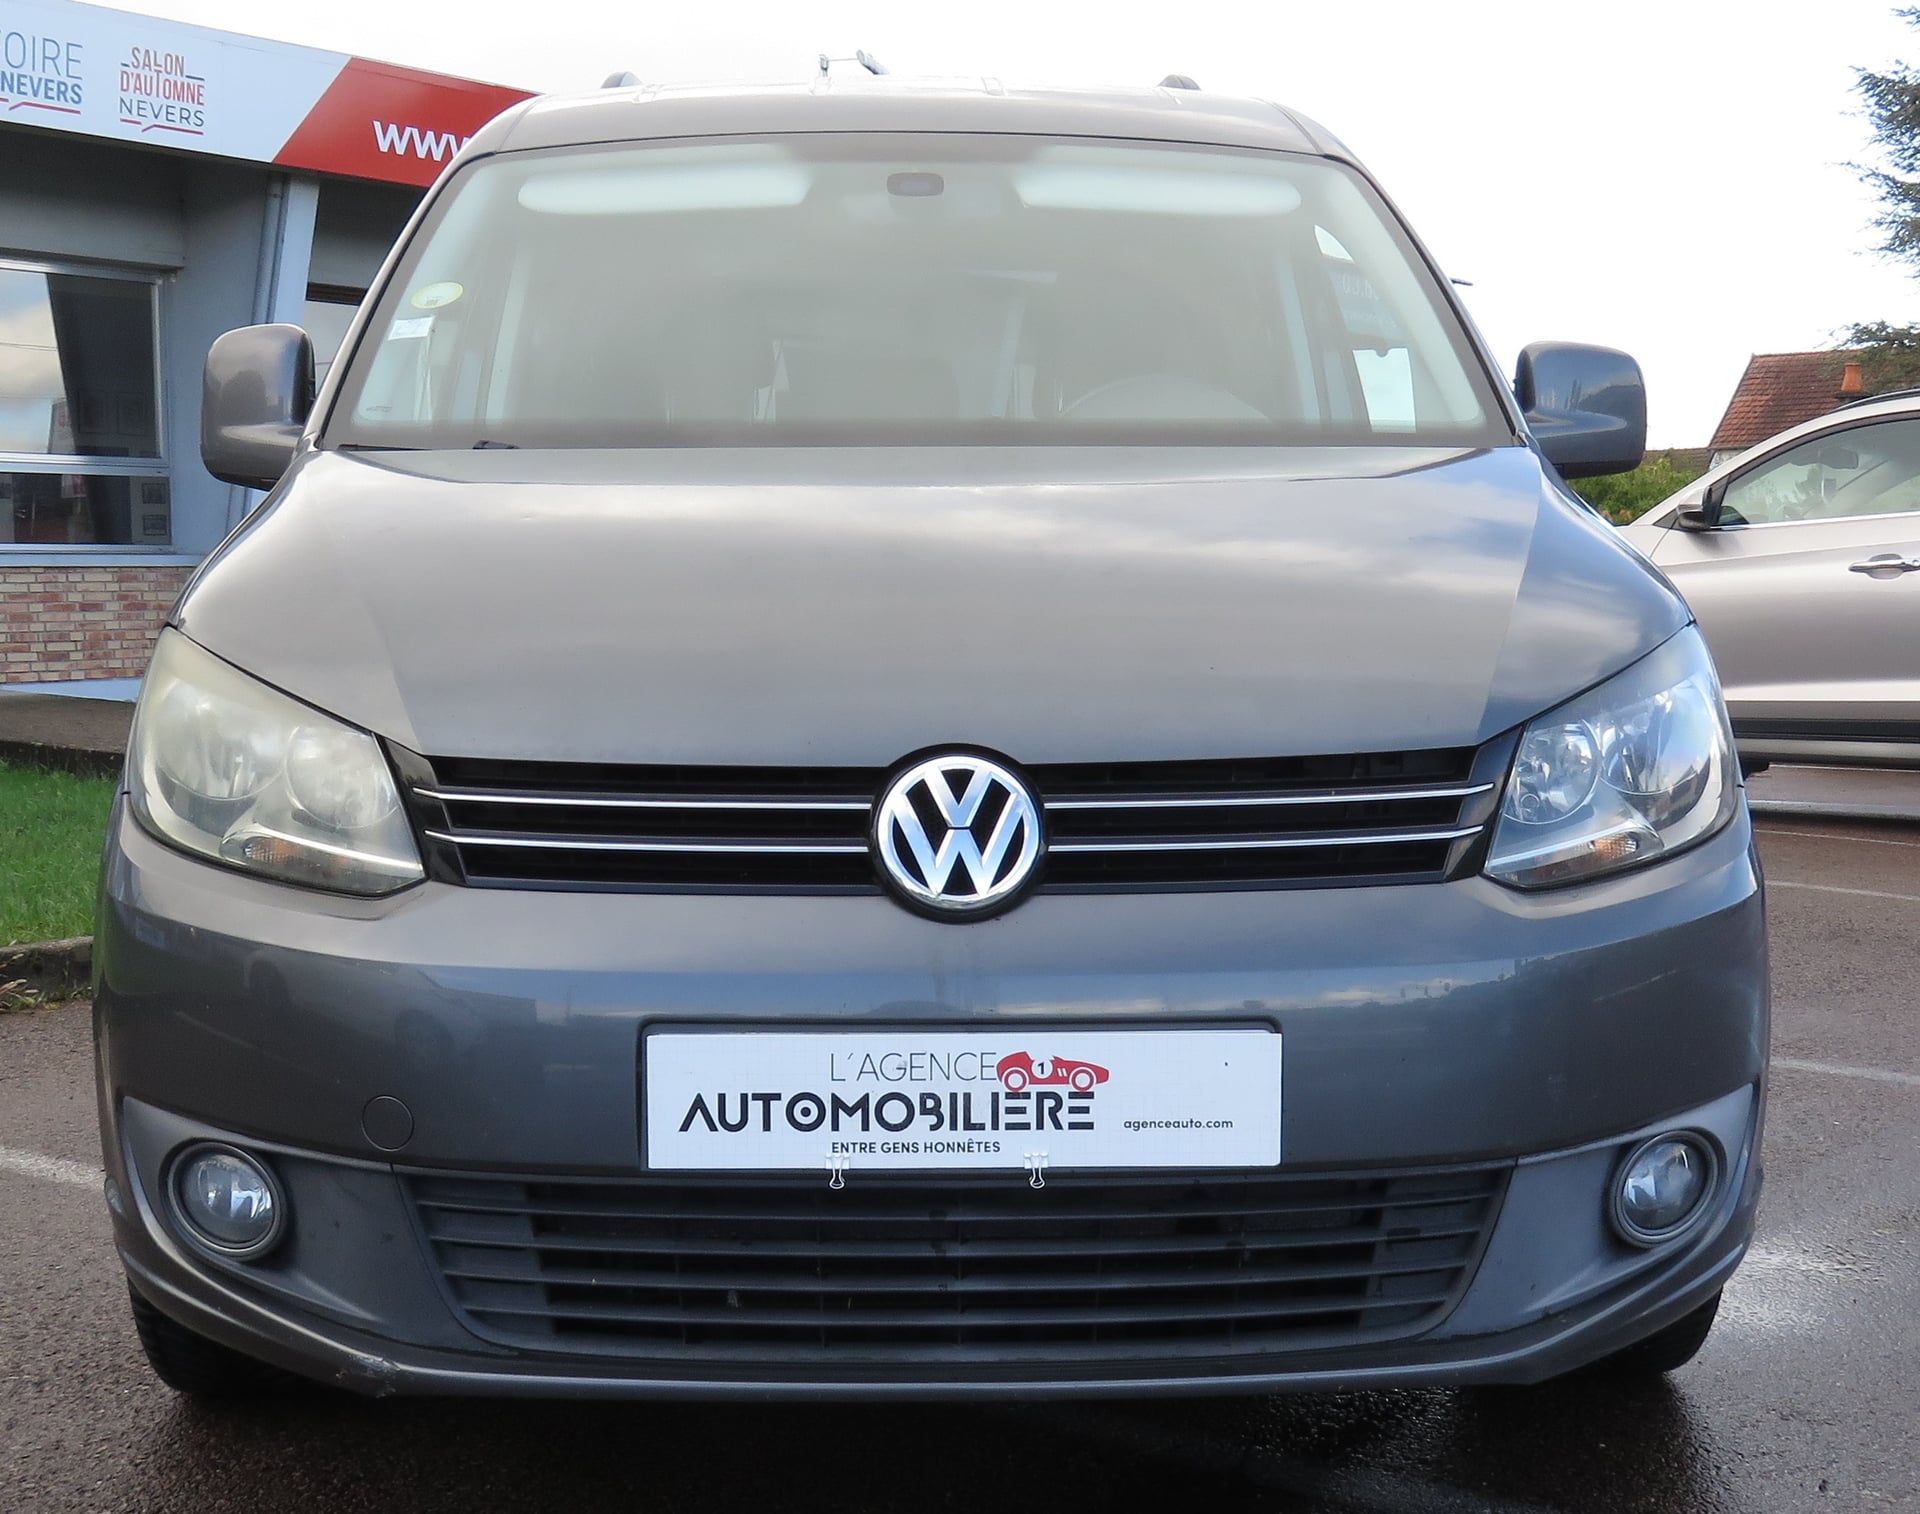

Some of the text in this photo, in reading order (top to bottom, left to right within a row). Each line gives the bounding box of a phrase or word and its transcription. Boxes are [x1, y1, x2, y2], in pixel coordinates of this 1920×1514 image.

[0, 31, 83, 80] OIRE
[131, 46, 185, 78] SALON
[0, 70, 82, 105] NEVERS
[120, 68, 205, 106] D'AUTOMNE
[119, 96, 205, 127] NEVERS
[831, 1052, 998, 1082] L'AGENCE
[1123, 1118, 1234, 1132] agenceauto.com
[831, 1137, 1001, 1154] ENTRE GENS HONNÊTES
